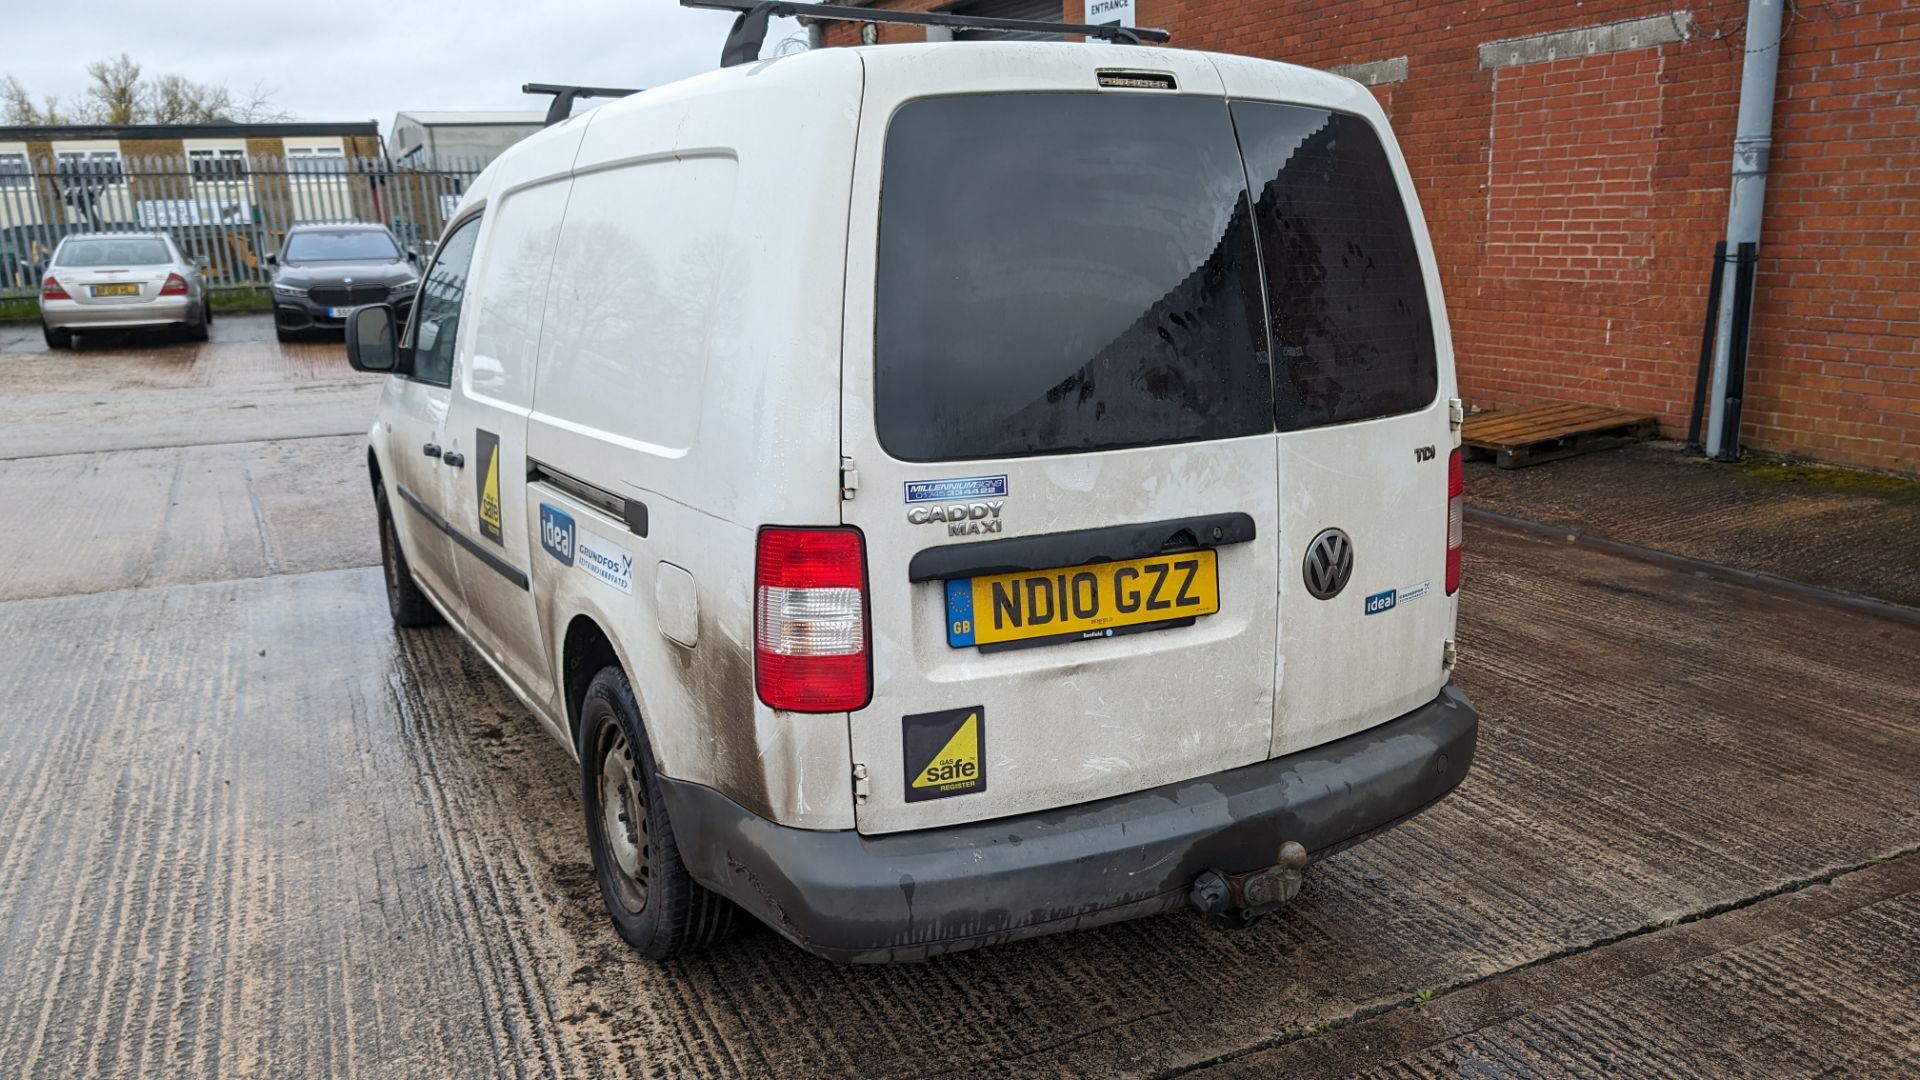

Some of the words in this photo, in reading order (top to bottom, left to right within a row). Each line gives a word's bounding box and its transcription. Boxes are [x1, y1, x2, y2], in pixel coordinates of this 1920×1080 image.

[1091, 0, 1128, 15] ENTRANCE
[1414, 444, 1435, 463] TDI
[908, 501, 1004, 524] CADDY
[542, 513, 573, 560] ideal
[948, 519, 1002, 536] MAXI
[579, 544, 620, 573] GRUNDFOS
[1113, 560, 1200, 614] GZZ
[1367, 592, 1394, 612] ideal
[953, 620, 972, 635] GB
[927, 759, 975, 782] safe
[941, 781, 975, 791] REGISTER
